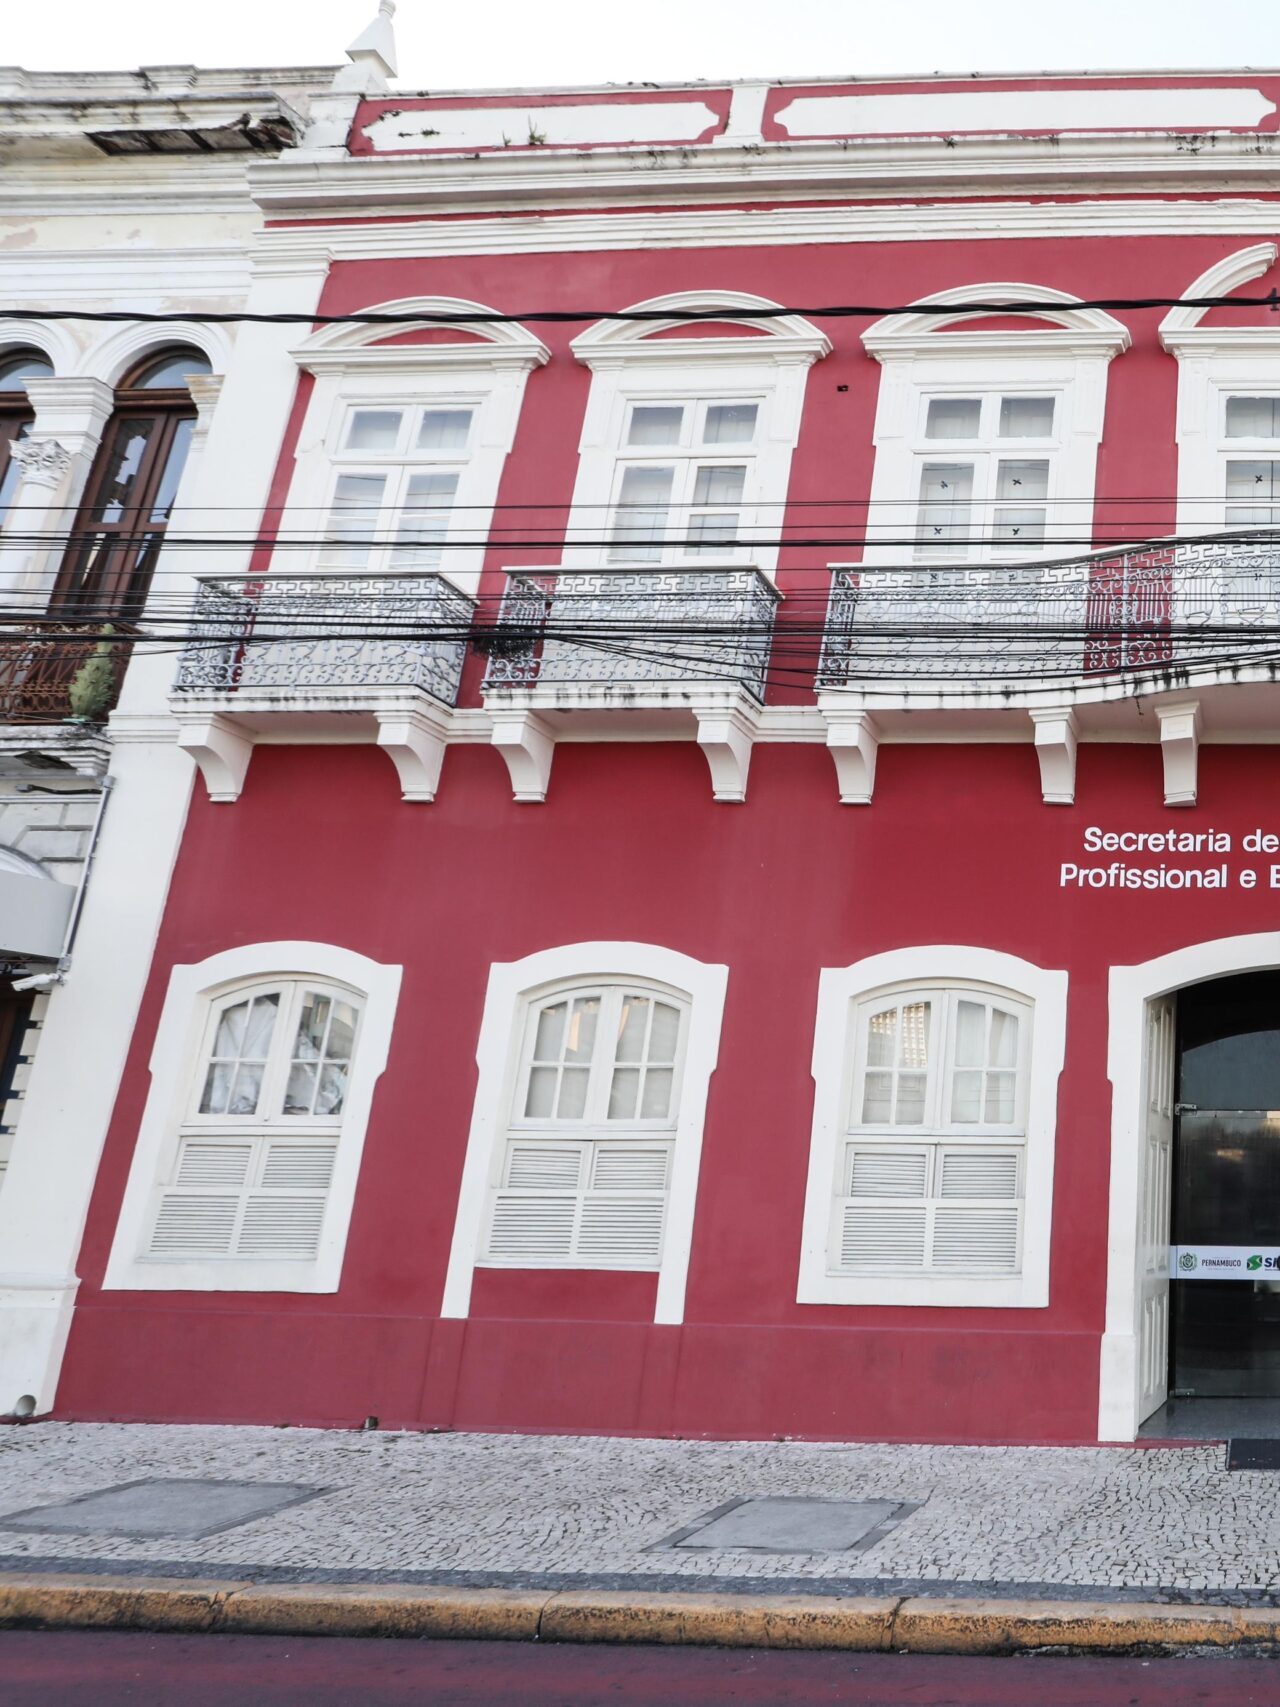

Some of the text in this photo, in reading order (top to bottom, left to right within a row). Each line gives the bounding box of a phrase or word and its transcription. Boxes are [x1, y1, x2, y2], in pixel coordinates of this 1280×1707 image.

[1083, 826, 1231, 853] Secretaria
[1242, 828, 1280, 853] de
[1059, 862, 1228, 890] Profissional
[1239, 869, 1257, 889] e
[1201, 1259, 1242, 1267] PERNAMBUCO
